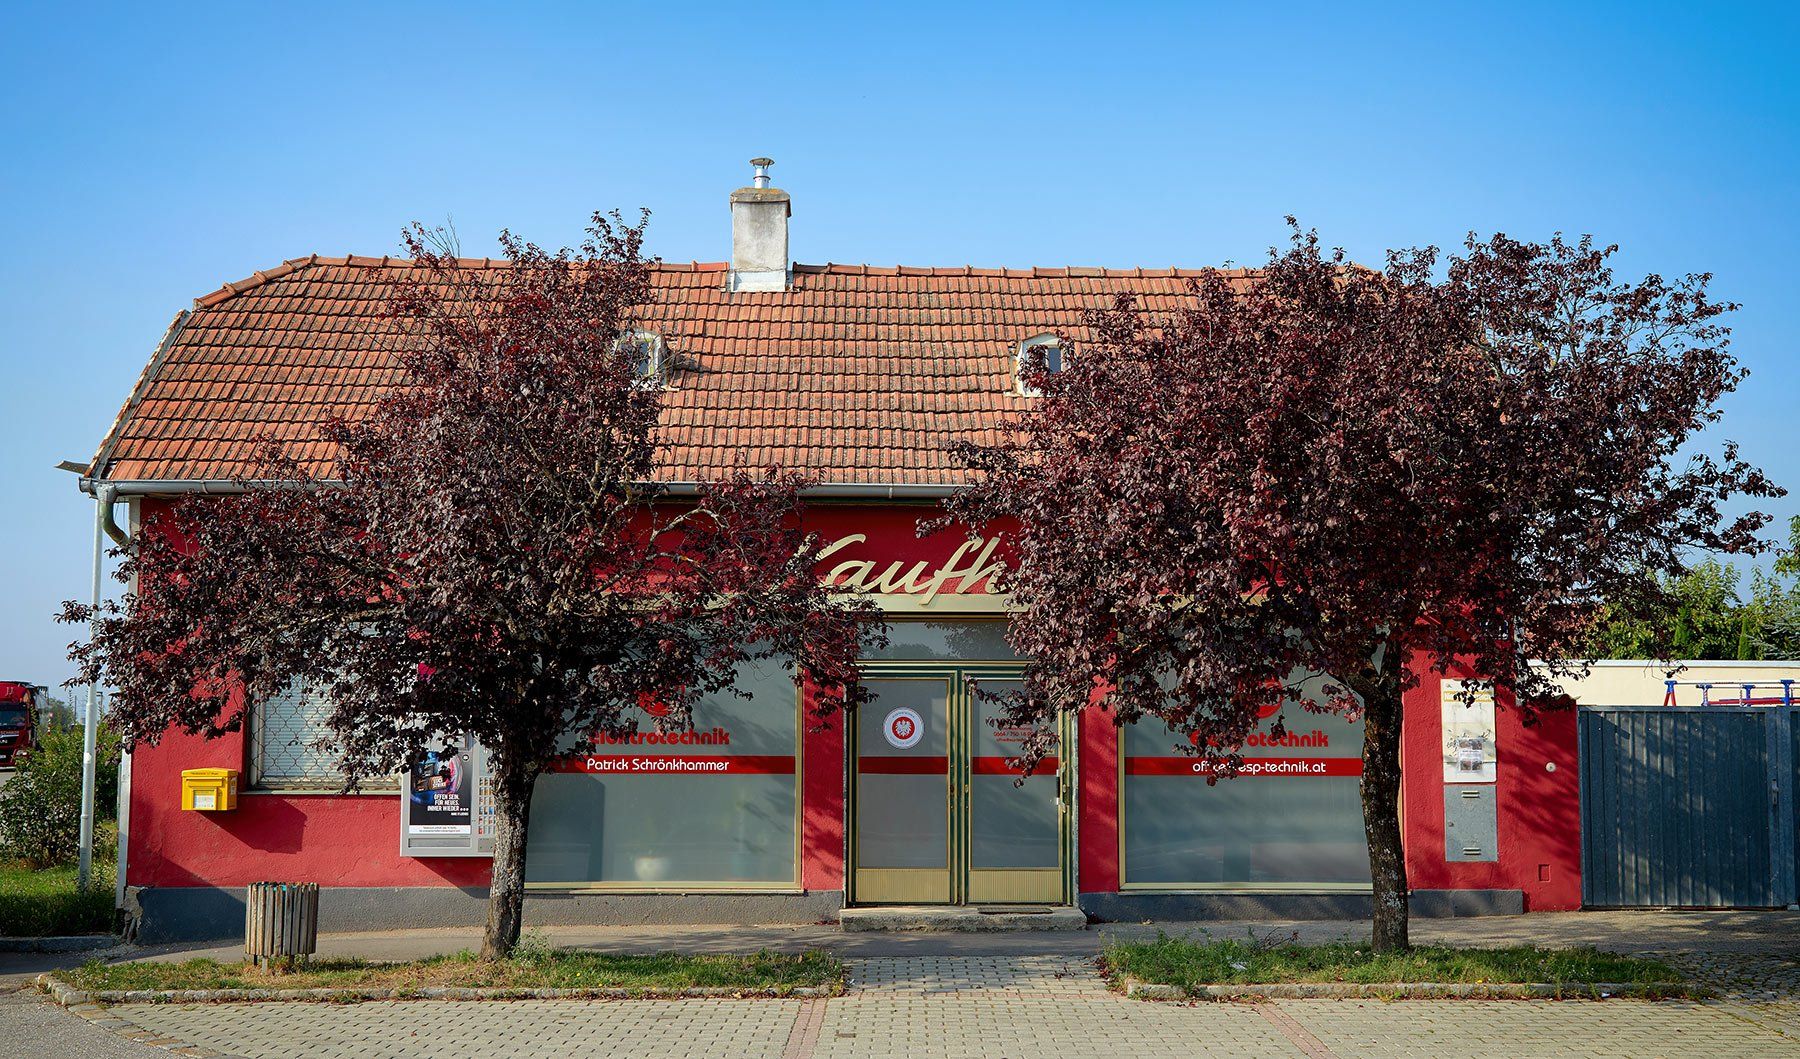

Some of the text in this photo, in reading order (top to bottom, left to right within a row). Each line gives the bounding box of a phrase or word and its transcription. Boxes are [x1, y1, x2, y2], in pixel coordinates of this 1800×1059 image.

[588, 727, 730, 745] ltrotechnik
[586, 758, 730, 770] Patrick Schrönkhammer
[1192, 760, 1327, 775] ofceesp-technik.at
